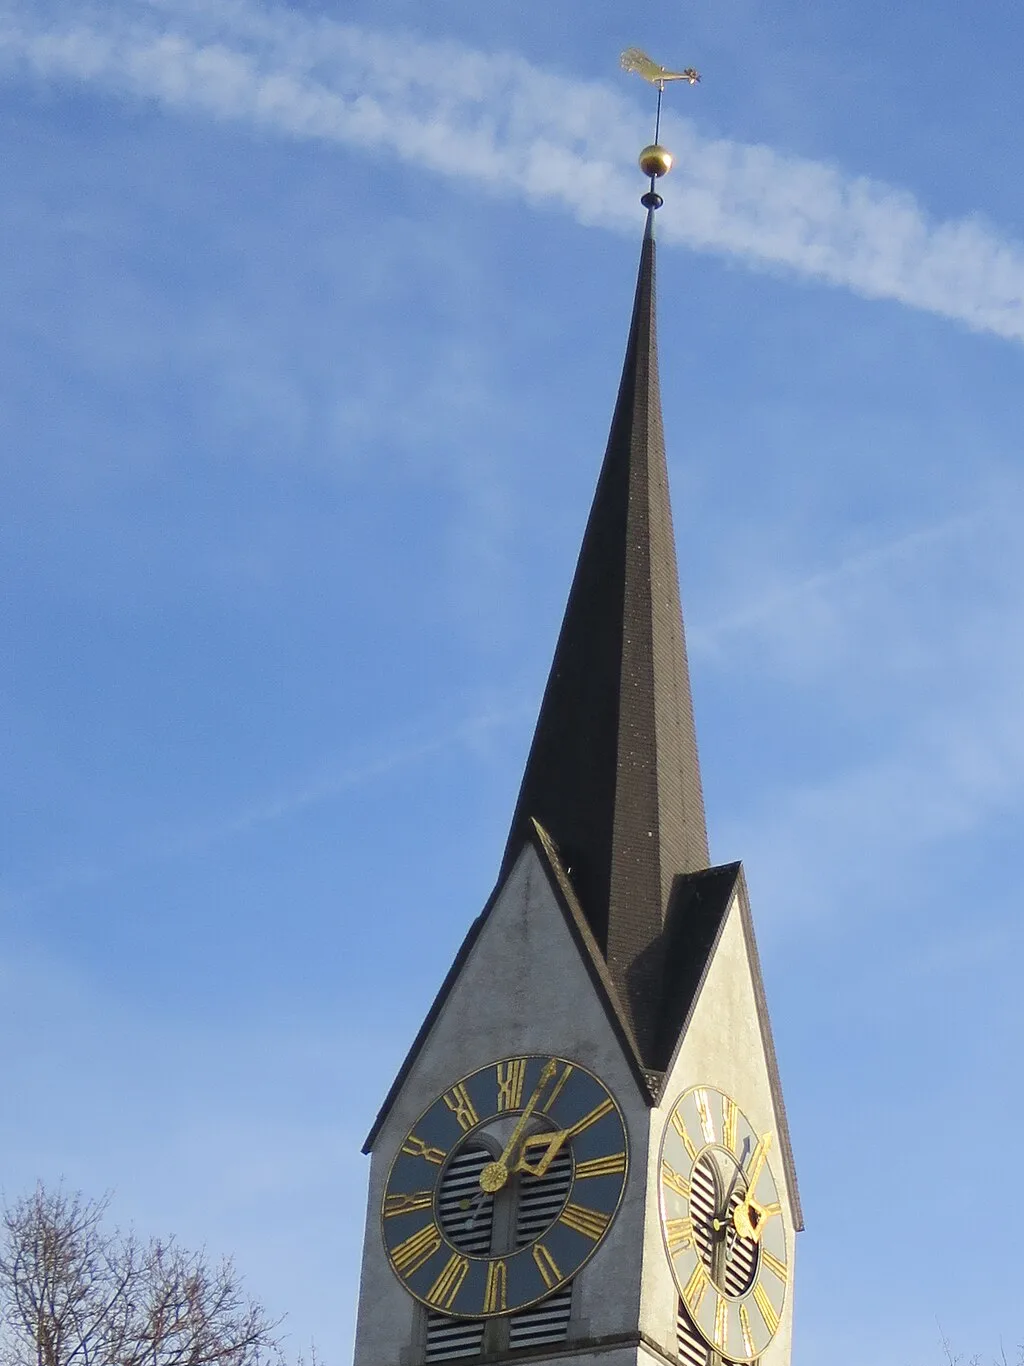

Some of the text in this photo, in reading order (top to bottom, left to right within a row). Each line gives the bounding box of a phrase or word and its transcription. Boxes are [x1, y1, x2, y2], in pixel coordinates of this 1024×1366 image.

[443, 1083, 479, 1131] XI
[497, 1059, 527, 1112] XII
[401, 1135, 447, 1164] X
[671, 1108, 698, 1161] X
[575, 1151, 626, 1179] III
[385, 1191, 432, 1217] IX
[559, 1203, 612, 1240] IIII
[390, 1223, 441, 1279] VIII
[532, 1243, 564, 1290] V
[426, 1252, 469, 1309] VII
[483, 1260, 507, 1312] VI
